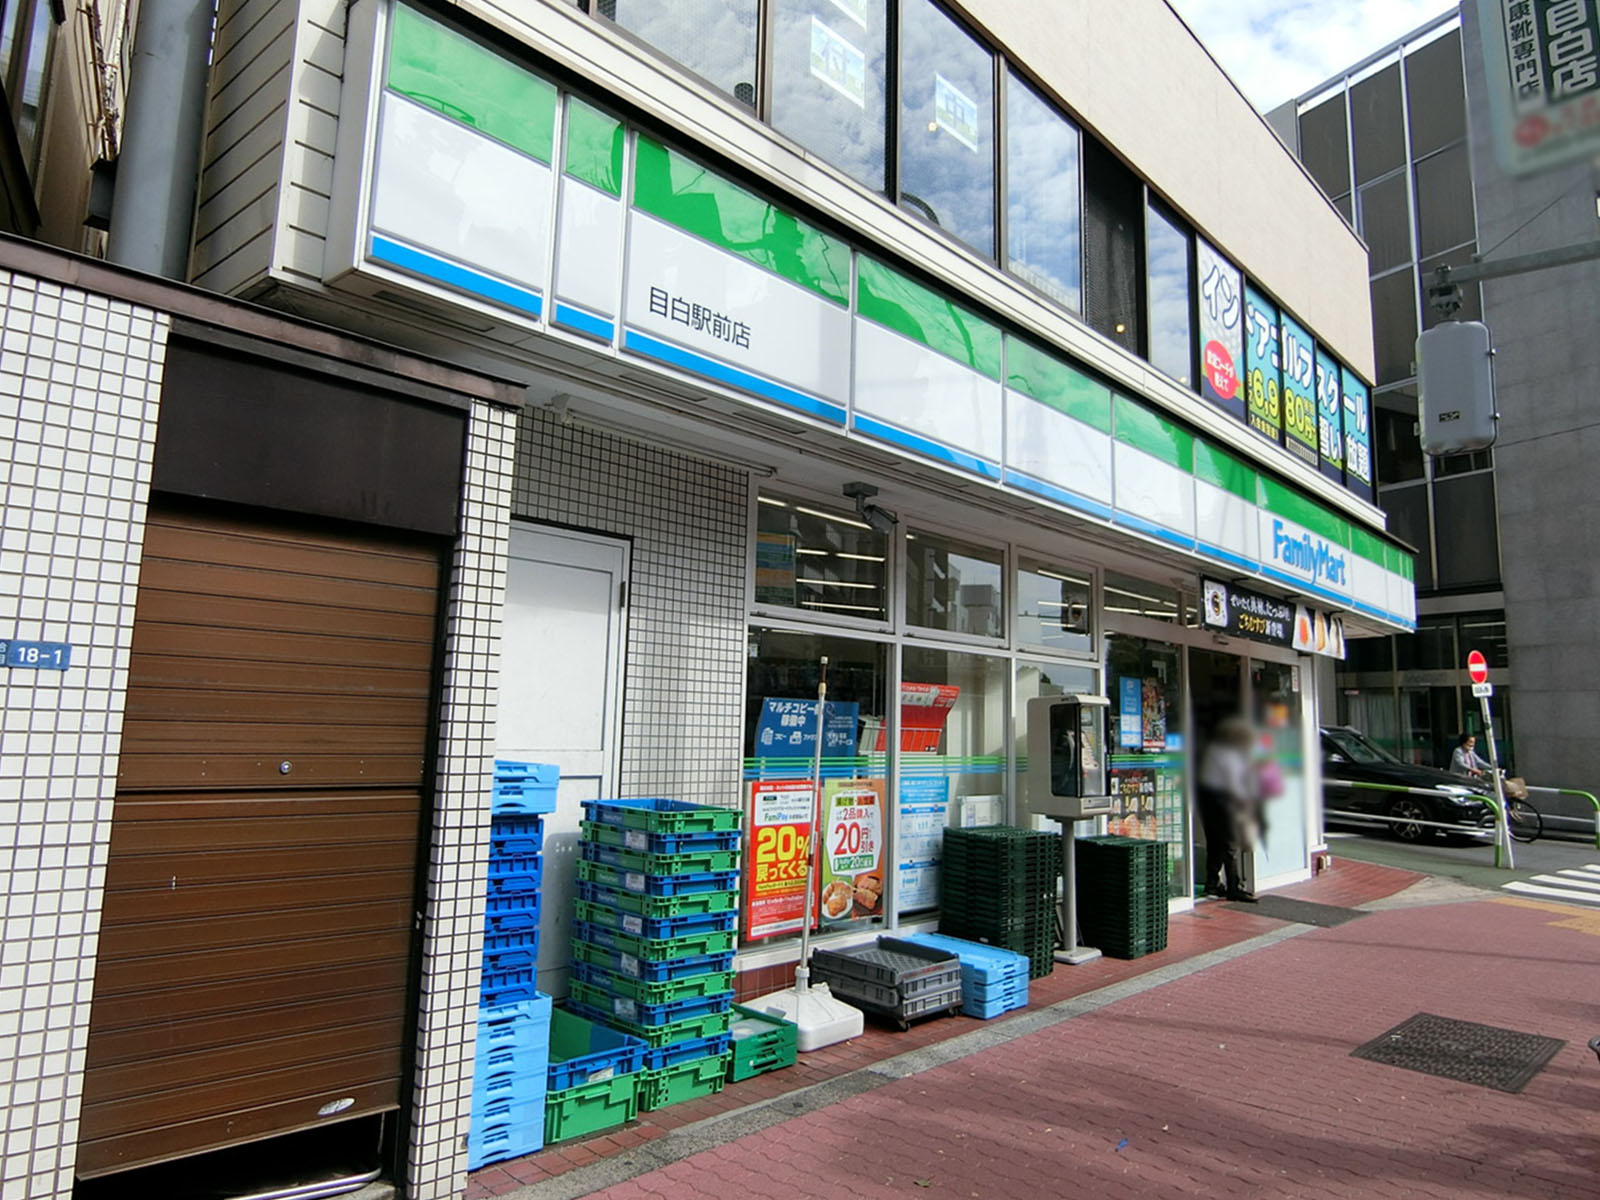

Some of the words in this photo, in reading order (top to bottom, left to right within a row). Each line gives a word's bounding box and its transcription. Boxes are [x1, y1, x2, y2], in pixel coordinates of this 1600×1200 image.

[650, 286, 750, 349] 目白駅前店
[1273, 519, 1346, 586] FamilyMart
[18, 647, 62, 665] 18-1
[756, 860, 808, 882] 戻ってくる
